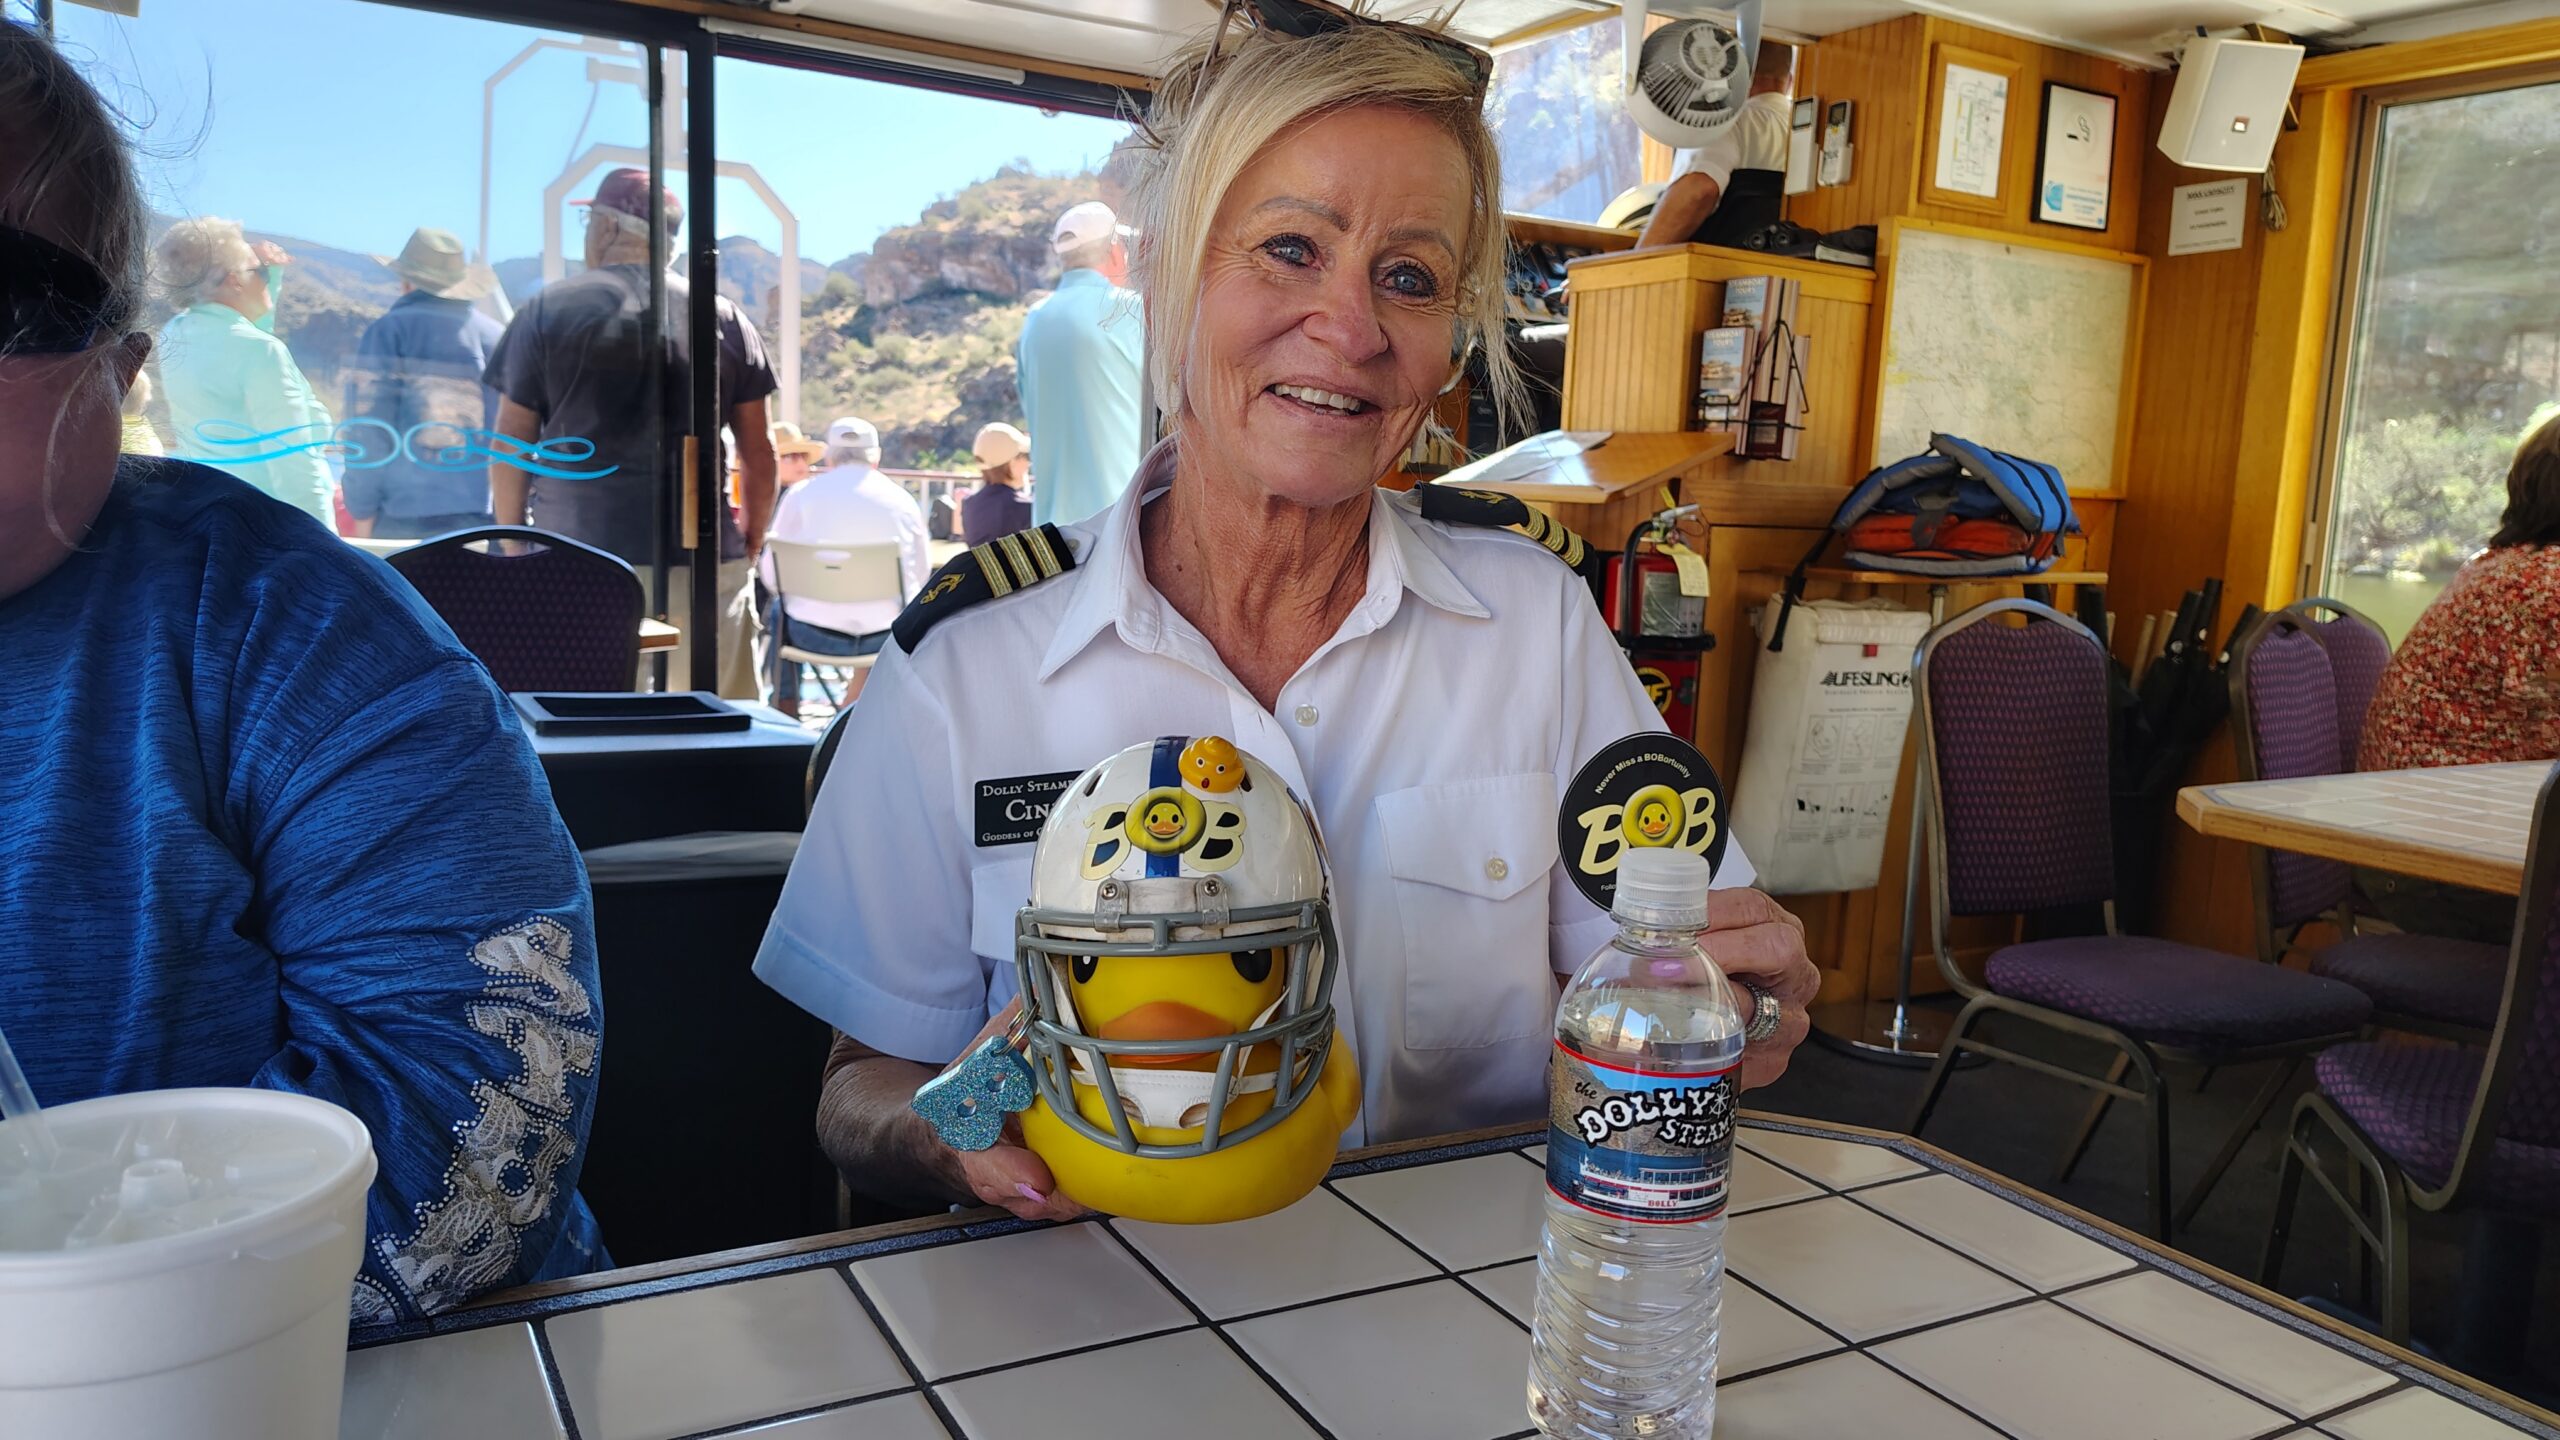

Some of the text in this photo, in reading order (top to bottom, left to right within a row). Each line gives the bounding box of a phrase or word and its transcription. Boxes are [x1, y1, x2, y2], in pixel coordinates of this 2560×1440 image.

[1595, 769, 1617, 795] Never
[1615, 757, 1636, 773] Miss
[1644, 752, 1691, 779] BOBortunity
[982, 784, 1024, 797] DOLLY
[1005, 798, 1054, 822] CIN
[982, 830, 1022, 842] GODDESS
[1577, 784, 1718, 876] BOB
[1575, 1081, 1598, 1100] the
[1577, 1089, 1716, 1143] DOLLY
[1647, 1199, 1679, 1208] DOLLY
